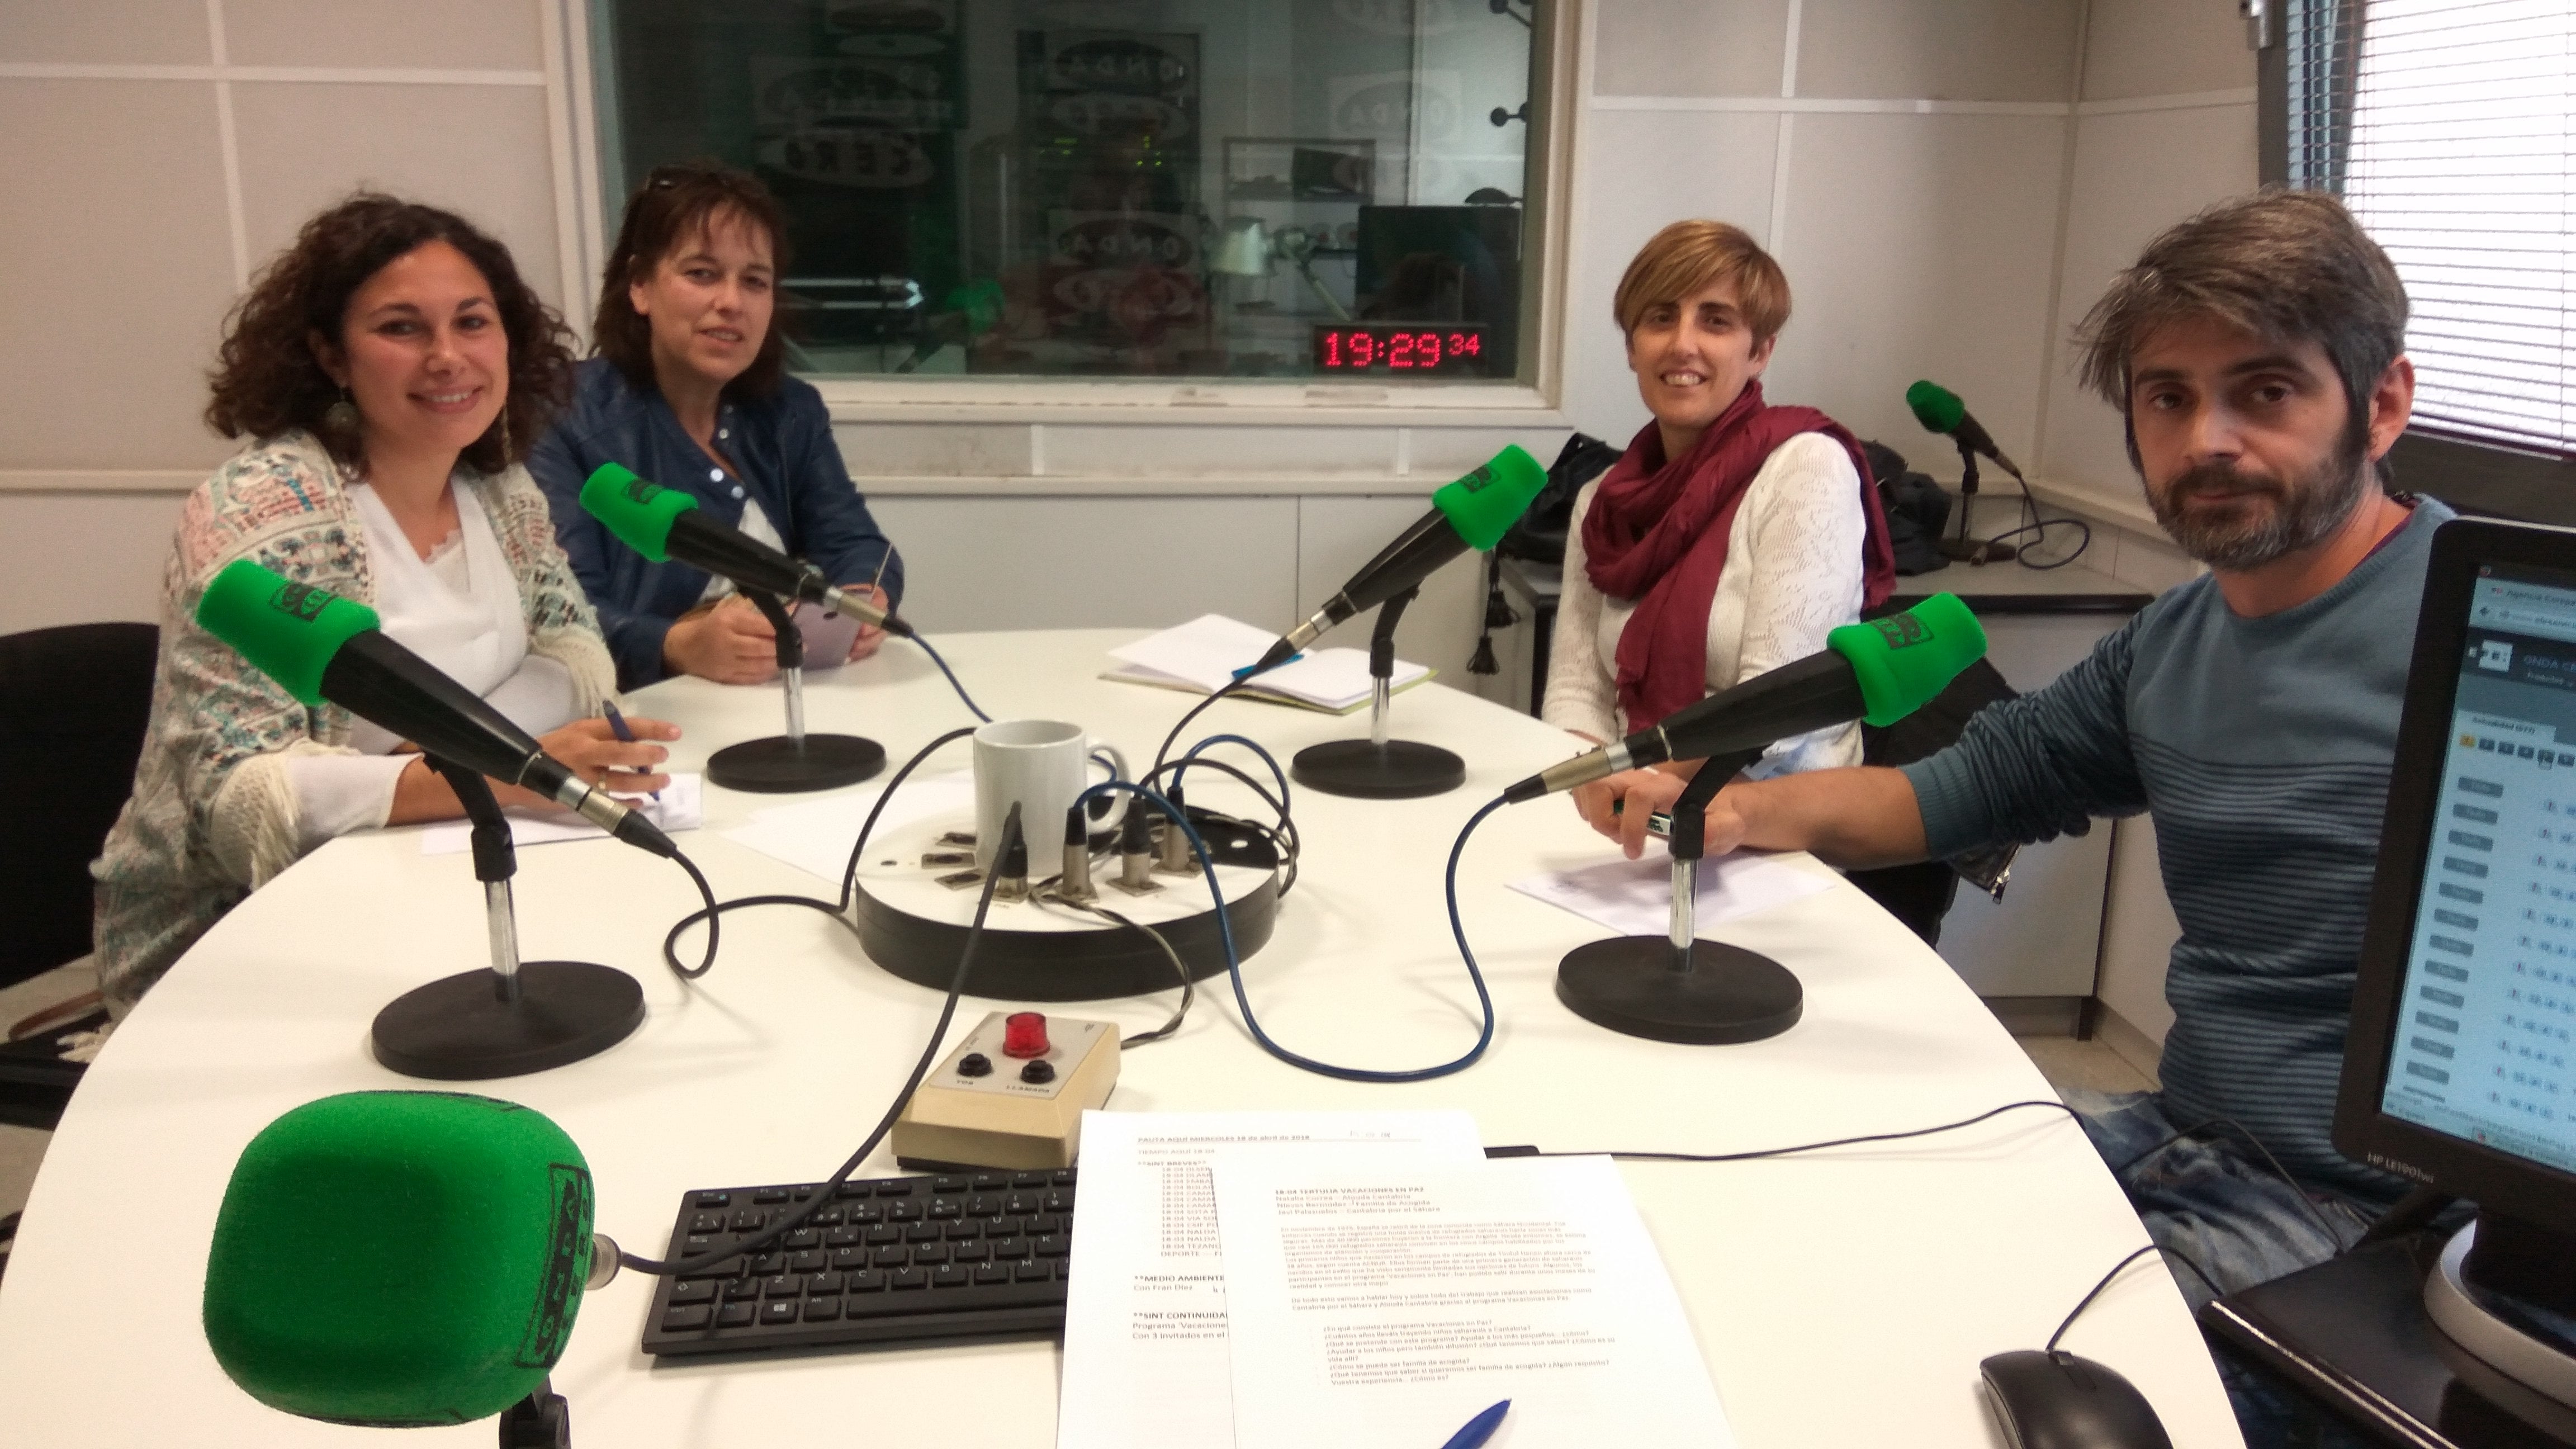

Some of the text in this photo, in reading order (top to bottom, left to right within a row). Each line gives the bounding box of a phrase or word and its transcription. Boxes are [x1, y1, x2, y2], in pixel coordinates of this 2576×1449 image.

[1326, 333, 1480, 367] 19:29 34
[2367, 1151, 2383, 1164] HP
[841, 1247, 850, 1256] D
[982, 1262, 991, 1270] N
[775, 1275, 784, 1284] Z
[816, 1272, 826, 1281] X
